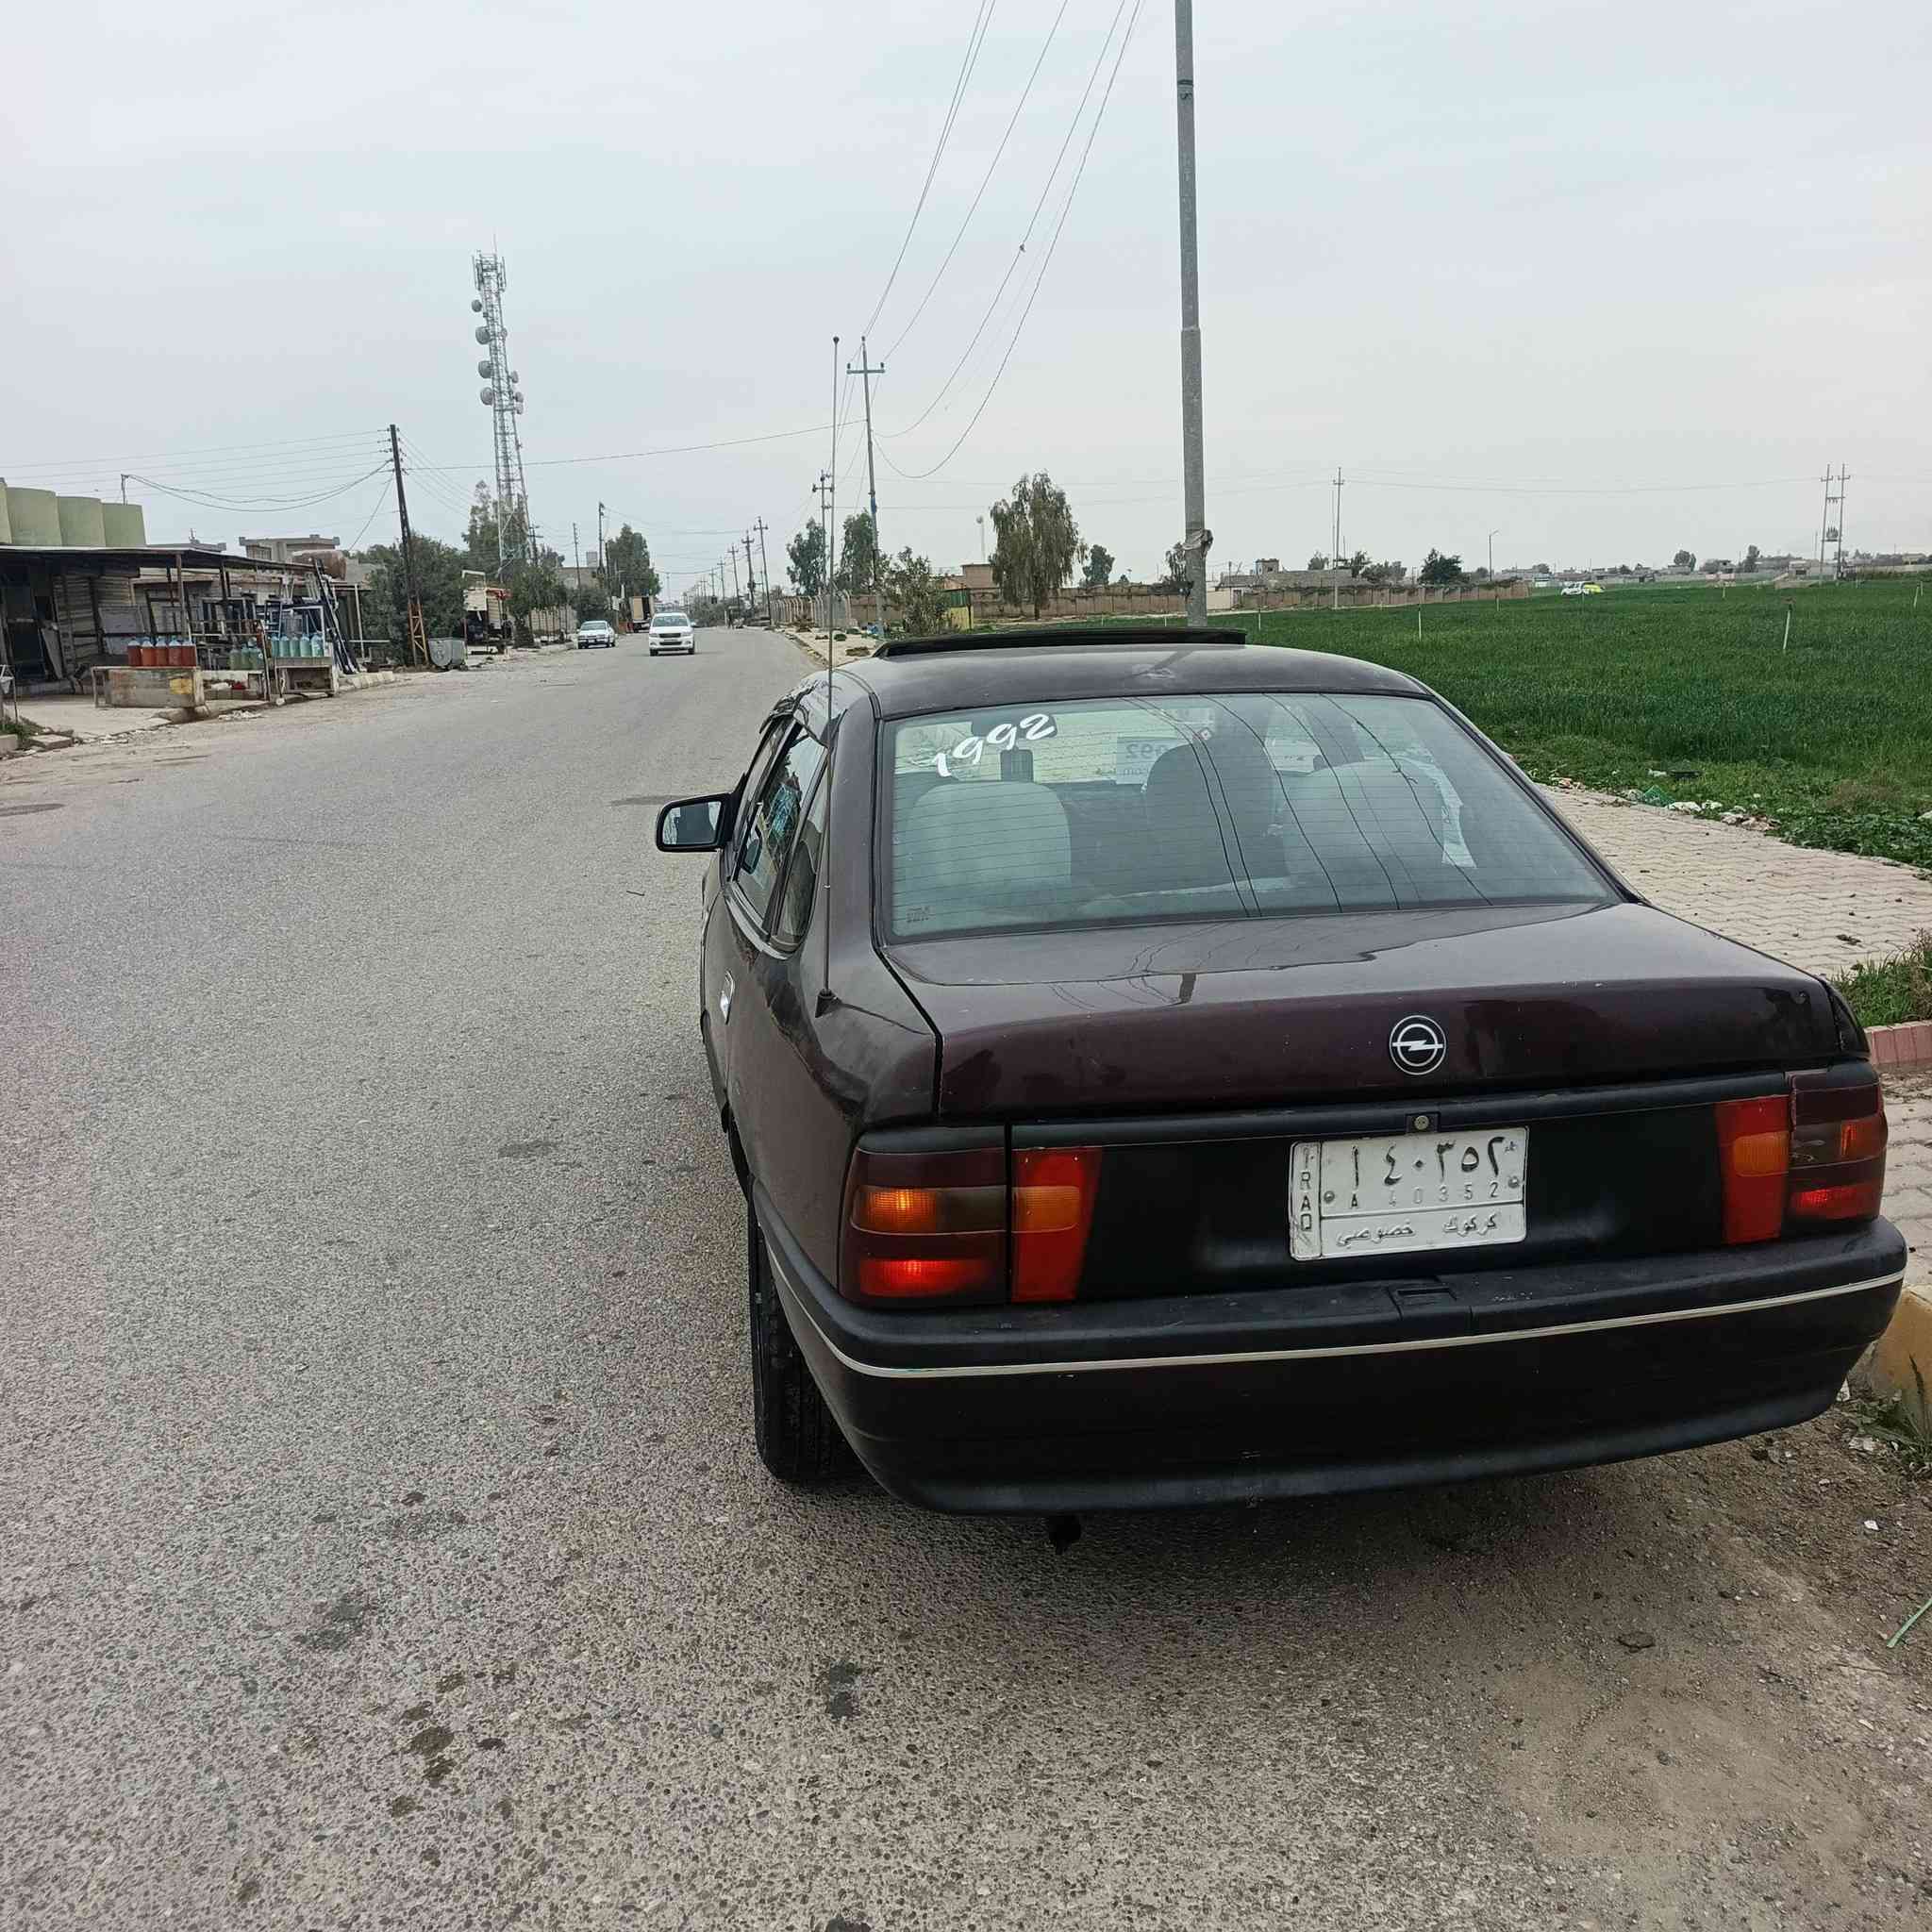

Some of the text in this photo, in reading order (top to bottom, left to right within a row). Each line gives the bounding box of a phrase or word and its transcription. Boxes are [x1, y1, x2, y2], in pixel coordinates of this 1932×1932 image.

[932, 714, 1056, 777] 1992
[1336, 1213, 1498, 1249] كركوك خصوصي
